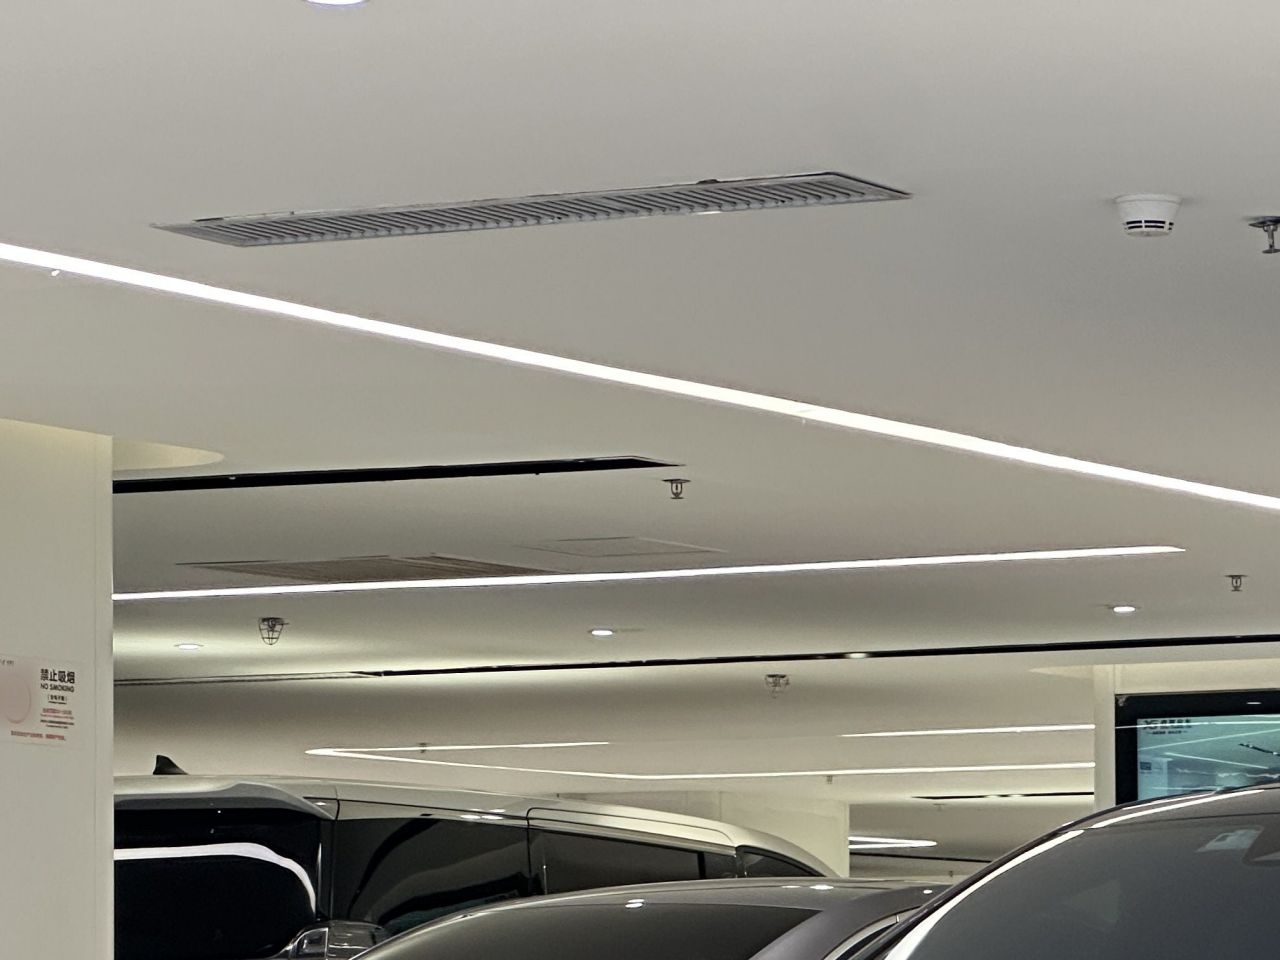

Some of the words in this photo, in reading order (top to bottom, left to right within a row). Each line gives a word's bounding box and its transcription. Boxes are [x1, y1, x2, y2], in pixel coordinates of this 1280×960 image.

[40, 668, 75, 684] 禁止吸烟
[49, 684, 75, 693] SMOKING
